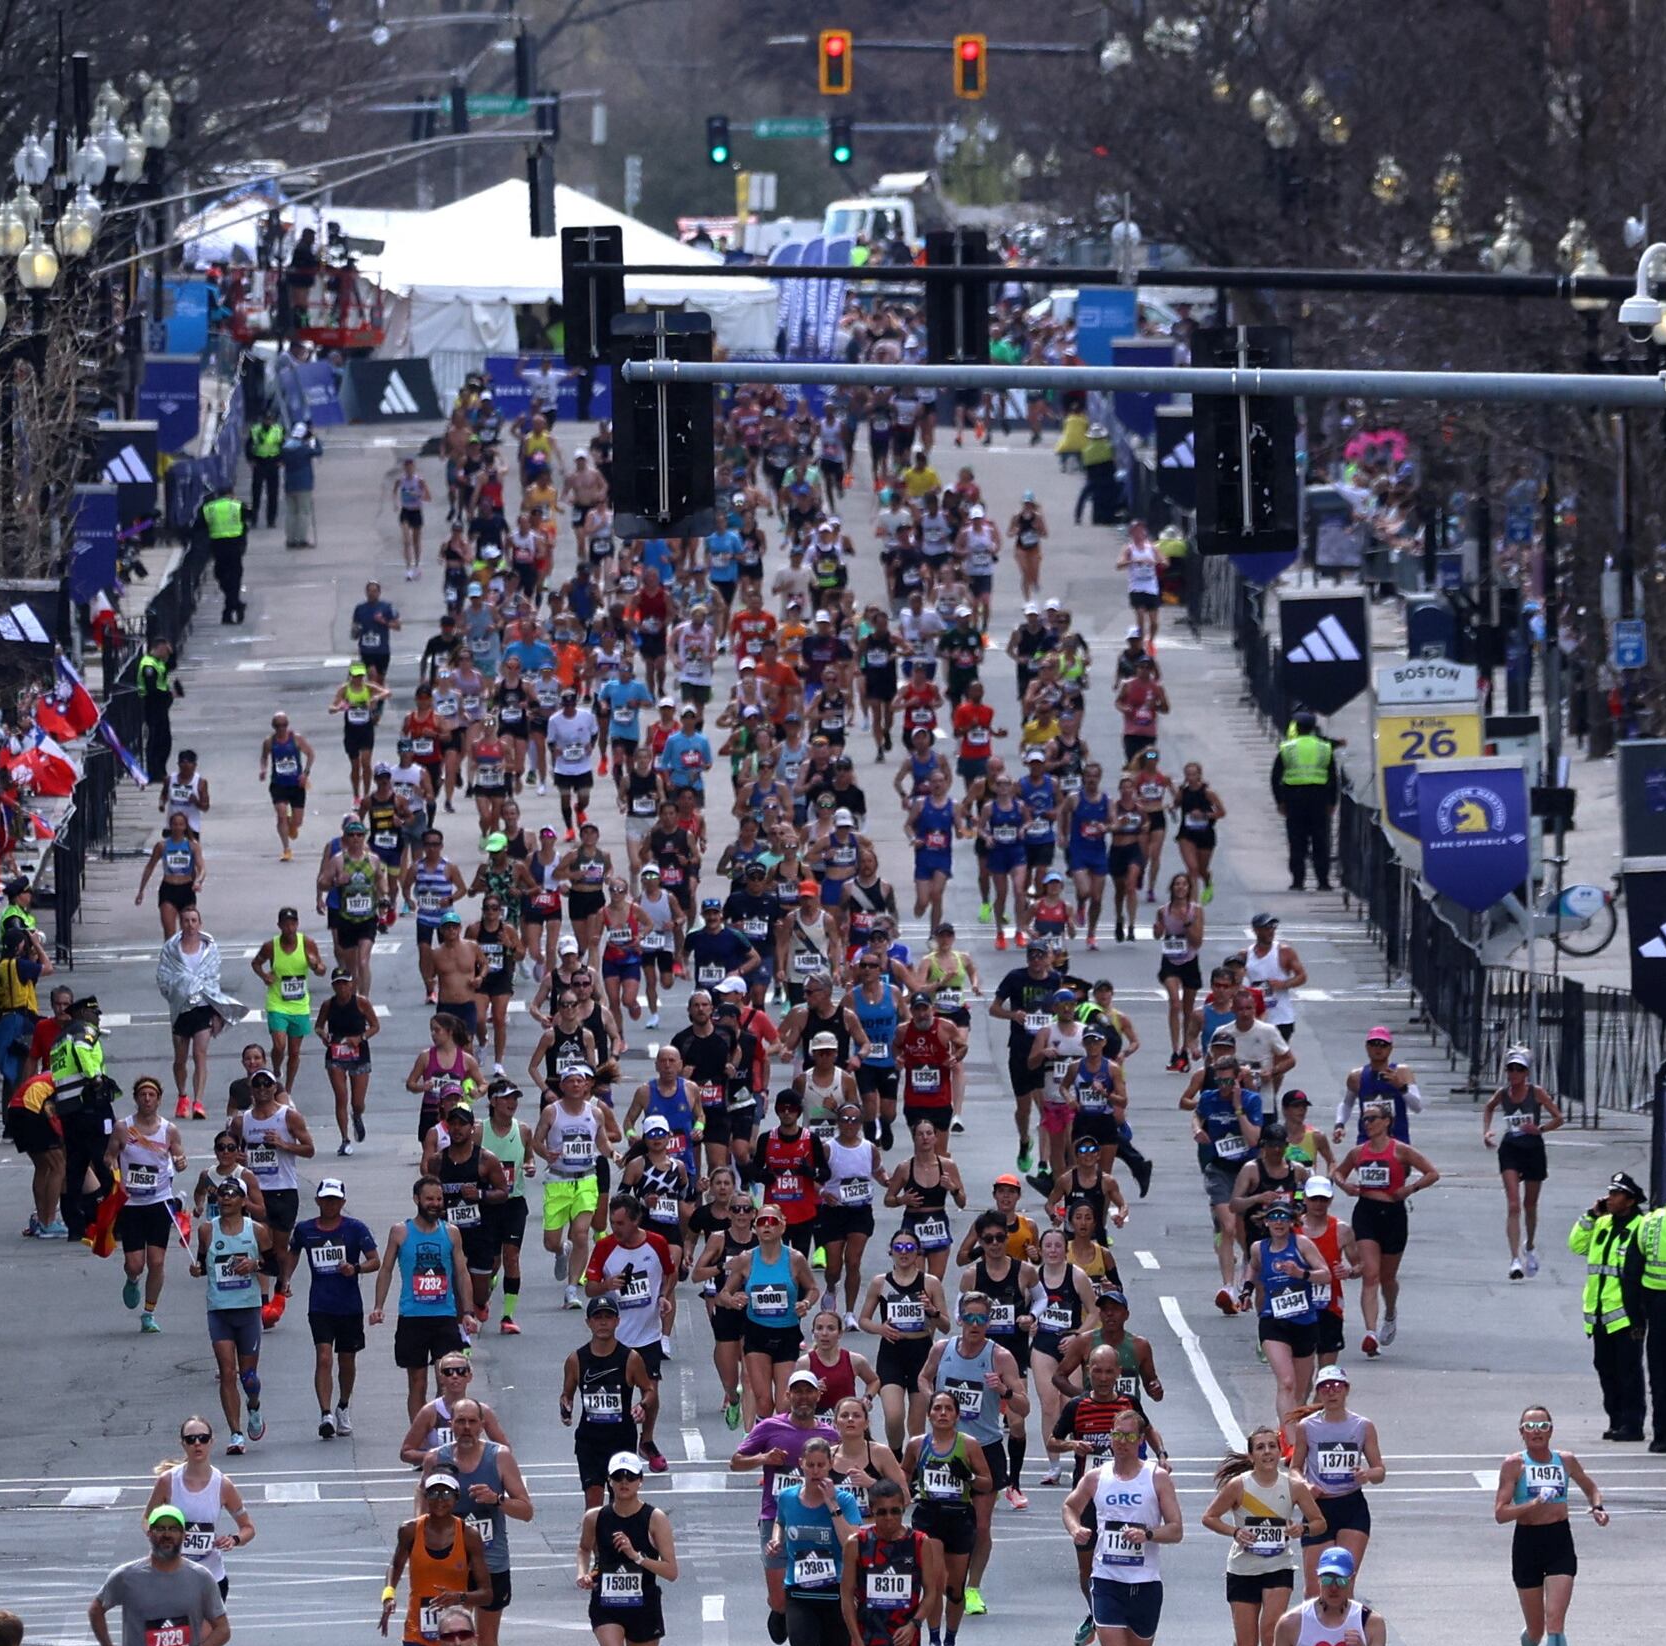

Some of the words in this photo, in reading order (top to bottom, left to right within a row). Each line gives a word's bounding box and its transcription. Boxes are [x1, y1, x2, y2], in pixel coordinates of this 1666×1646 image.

[1394, 667, 1461, 683] BOSTON
[1400, 730, 1457, 761] 26
[1468, 837, 1507, 847] AMERICA
[777, 1177, 799, 1190] 1544
[418, 1277, 441, 1291] 7332
[892, 1305, 921, 1318] 13085
[990, 1308, 1007, 1320] 283
[1083, 1433, 1112, 1441] SINGA
[1323, 1452, 1355, 1468] 13718
[1531, 1466, 1562, 1480] 14975
[928, 1473, 961, 1489] 14148
[1106, 1493, 1142, 1505] GRC
[184, 1534, 212, 1549] 5457
[799, 1560, 834, 1578] 13381
[605, 1576, 639, 1591] 15303
[874, 1577, 905, 1593] 8310
[153, 1630, 184, 1646] 7329
